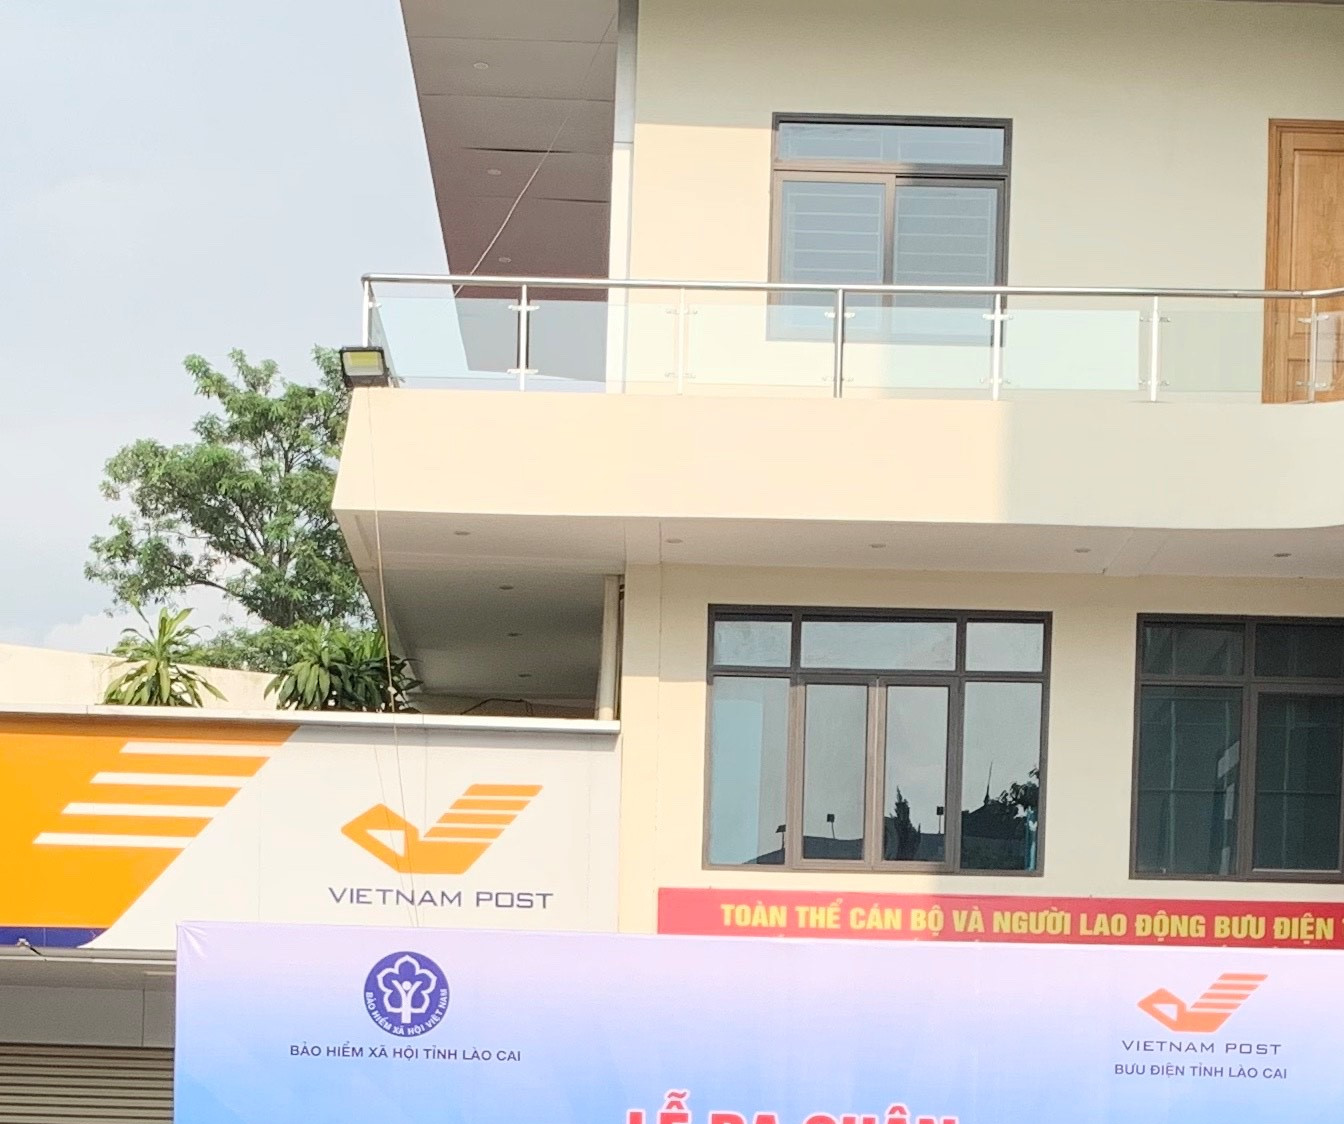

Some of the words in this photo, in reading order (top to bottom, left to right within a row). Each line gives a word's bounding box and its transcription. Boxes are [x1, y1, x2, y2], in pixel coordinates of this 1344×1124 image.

[328, 887, 462, 907] VIETNAM
[476, 892, 554, 909] POST
[721, 901, 787, 928] TOÀN
[796, 898, 843, 929] THỂ
[850, 904, 902, 930] CÁN
[910, 905, 944, 936] BỘ
[952, 905, 985, 932] VÀ
[992, 906, 1071, 935] NGƯỜI
[1079, 912, 1127, 937] LAO
[1135, 910, 1206, 942] ĐỘNG
[1214, 915, 1266, 940] BƯU
[1273, 912, 1334, 944] ĐIỆN
[290, 1041, 322, 1057] BẢO
[327, 1041, 364, 1058] HIỂM
[368, 1045, 387, 1058] XÃ
[393, 1045, 418, 1061] HỘI
[423, 1045, 457, 1060] TỈNH
[462, 1046, 492, 1061] LÀO
[497, 1050, 521, 1062] CAI
[1121, 1040, 1215, 1054] VIETNAM
[1225, 1043, 1282, 1055] POST
[1114, 1063, 1146, 1075] BƯU
[1150, 1062, 1185, 1078] ĐIỆN
[1190, 1062, 1224, 1078] TỈNH
[1228, 1064, 1258, 1079] LÀO
[1262, 1068, 1287, 1079] CAI
